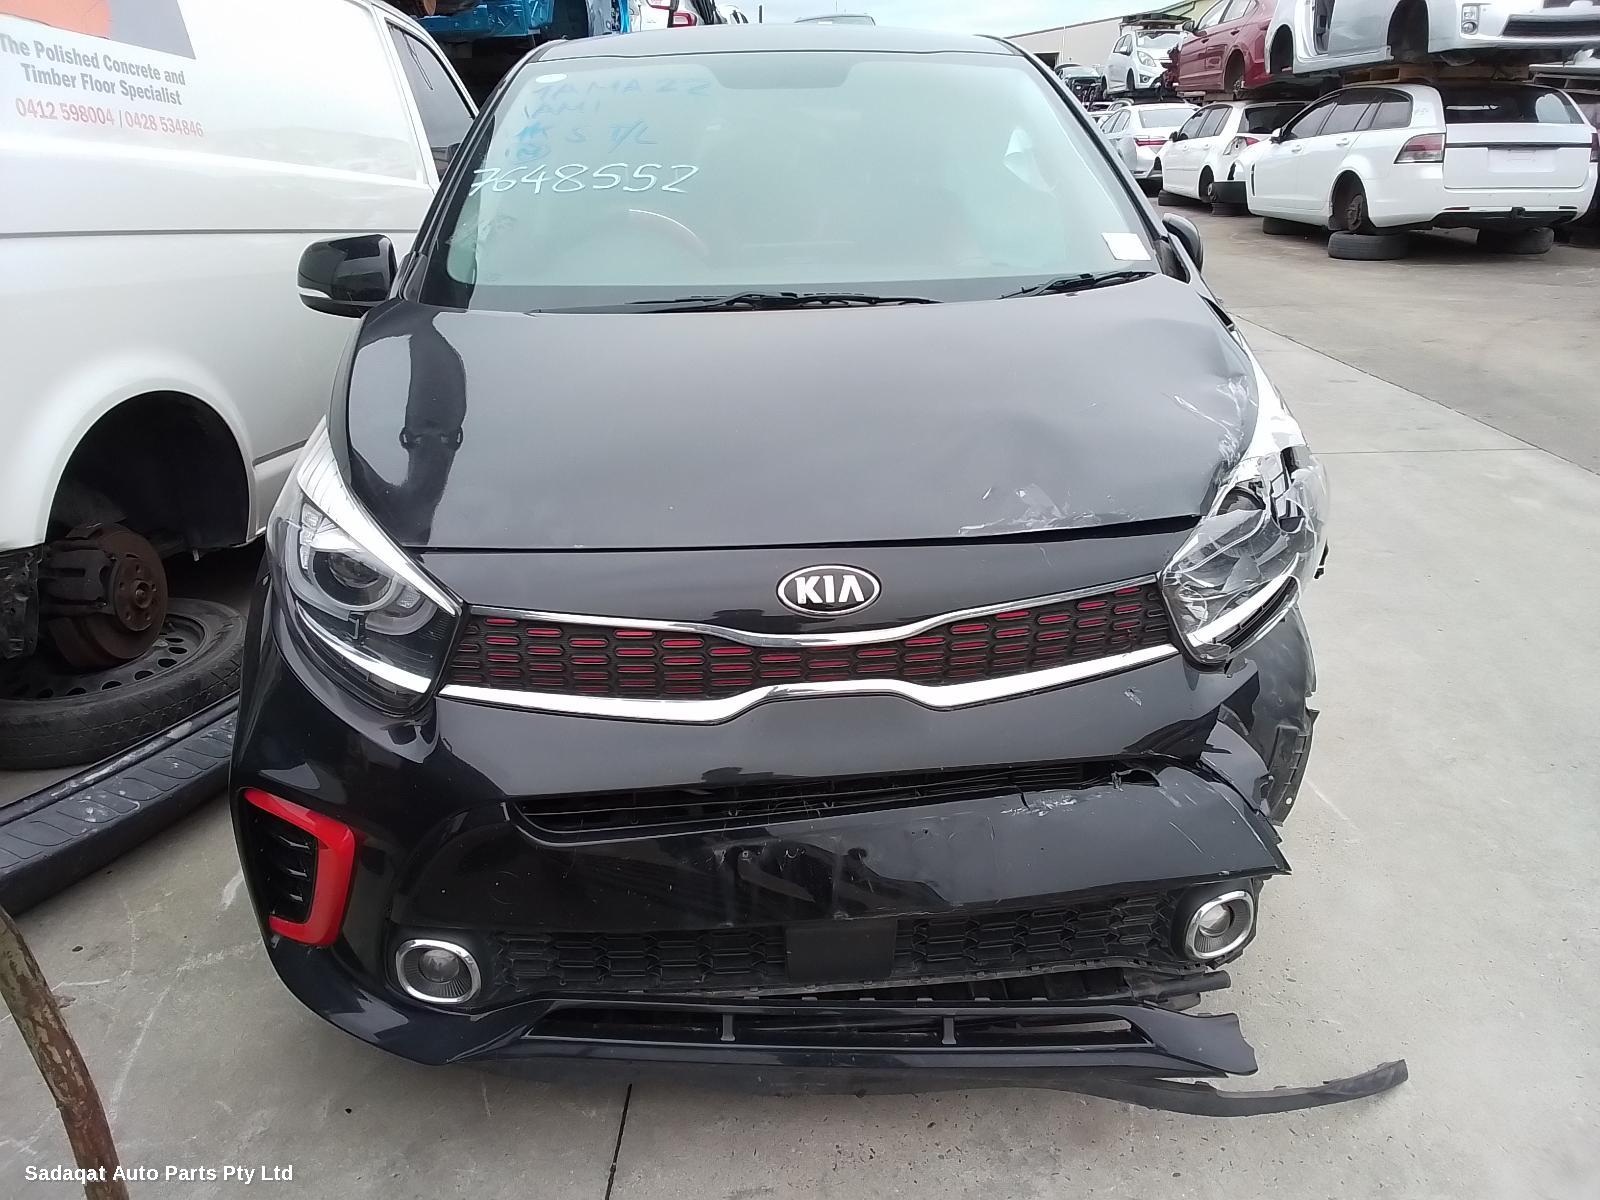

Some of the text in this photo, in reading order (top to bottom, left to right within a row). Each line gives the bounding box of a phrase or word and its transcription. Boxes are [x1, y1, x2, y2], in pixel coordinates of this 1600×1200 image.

[0, 32, 186, 86] The Polished Concrete and
[20, 62, 183, 105] Timber Floor Specialist
[15, 97, 58, 120] 0412
[59, 102, 115, 126] 598004
[159, 116, 204, 137] 534846
[468, 163, 700, 196] 7648552
[795, 575, 865, 604] KIA
